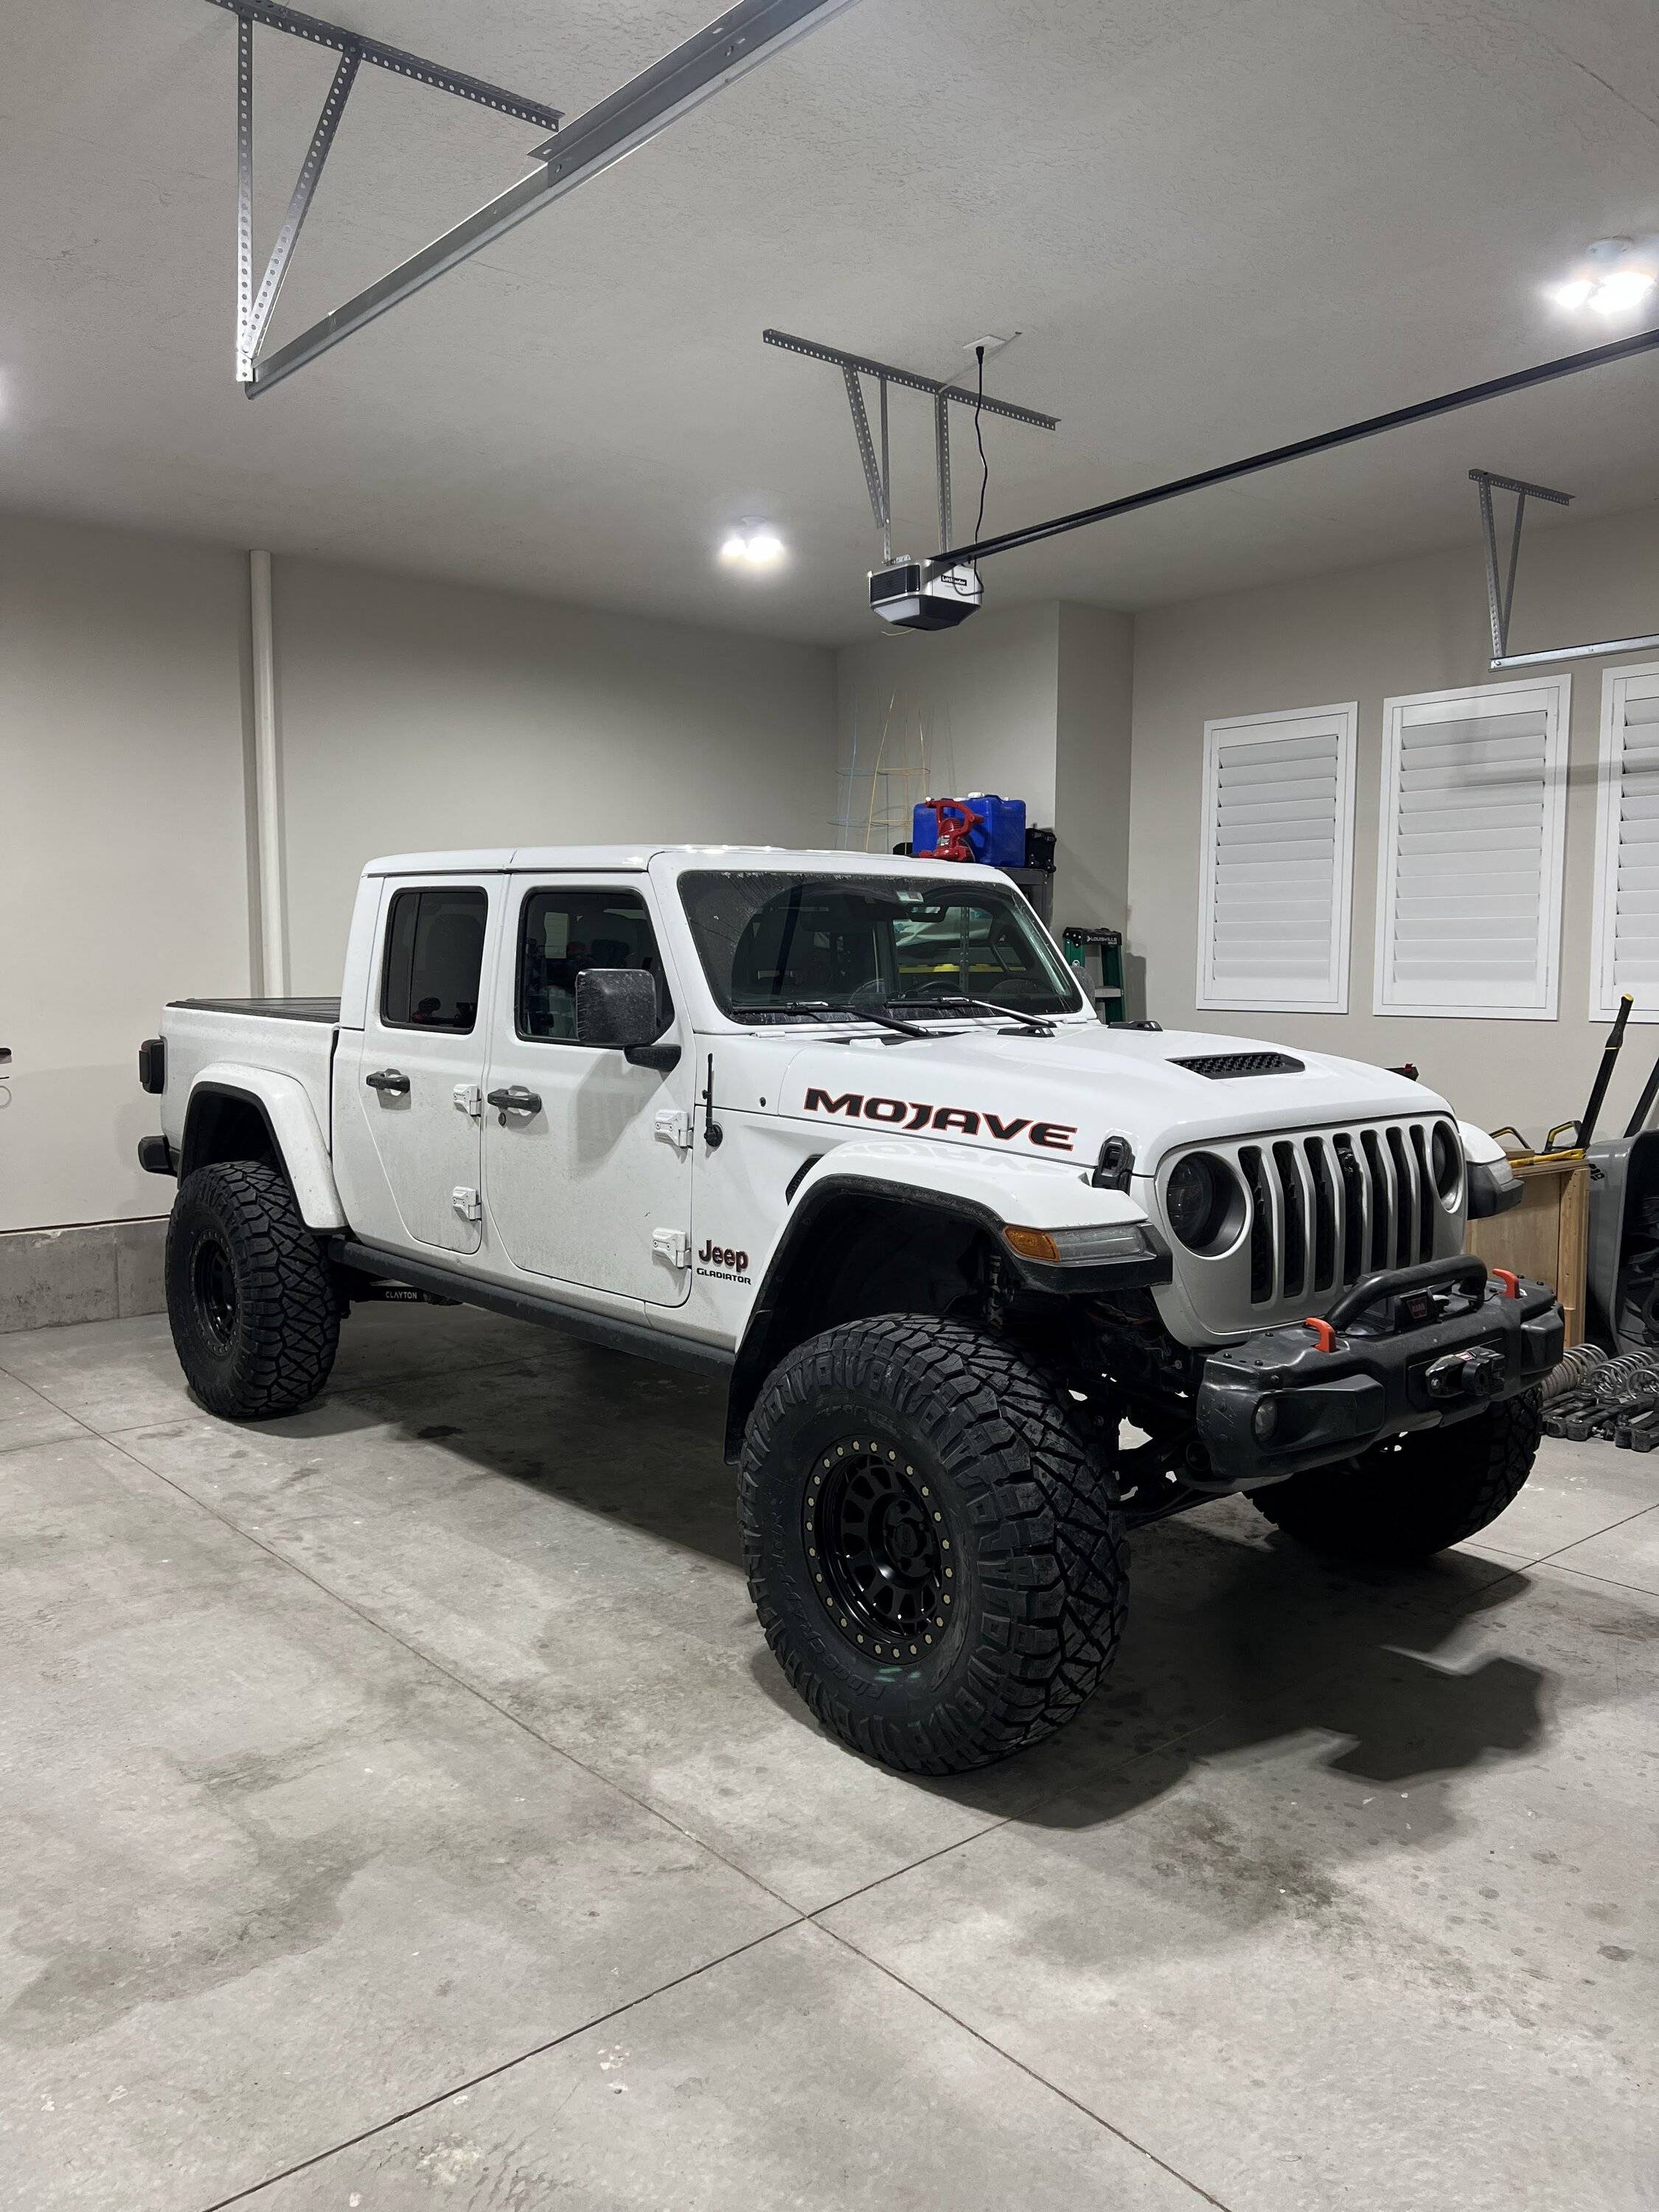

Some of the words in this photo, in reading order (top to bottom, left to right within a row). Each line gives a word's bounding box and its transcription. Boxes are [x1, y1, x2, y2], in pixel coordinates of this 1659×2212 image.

[803, 1087, 1078, 1152] MOJAVE
[698, 1239, 749, 1273] Jeep
[696, 1267, 751, 1285] GLADIATOR
[385, 1291, 418, 1299] CLAYTON
